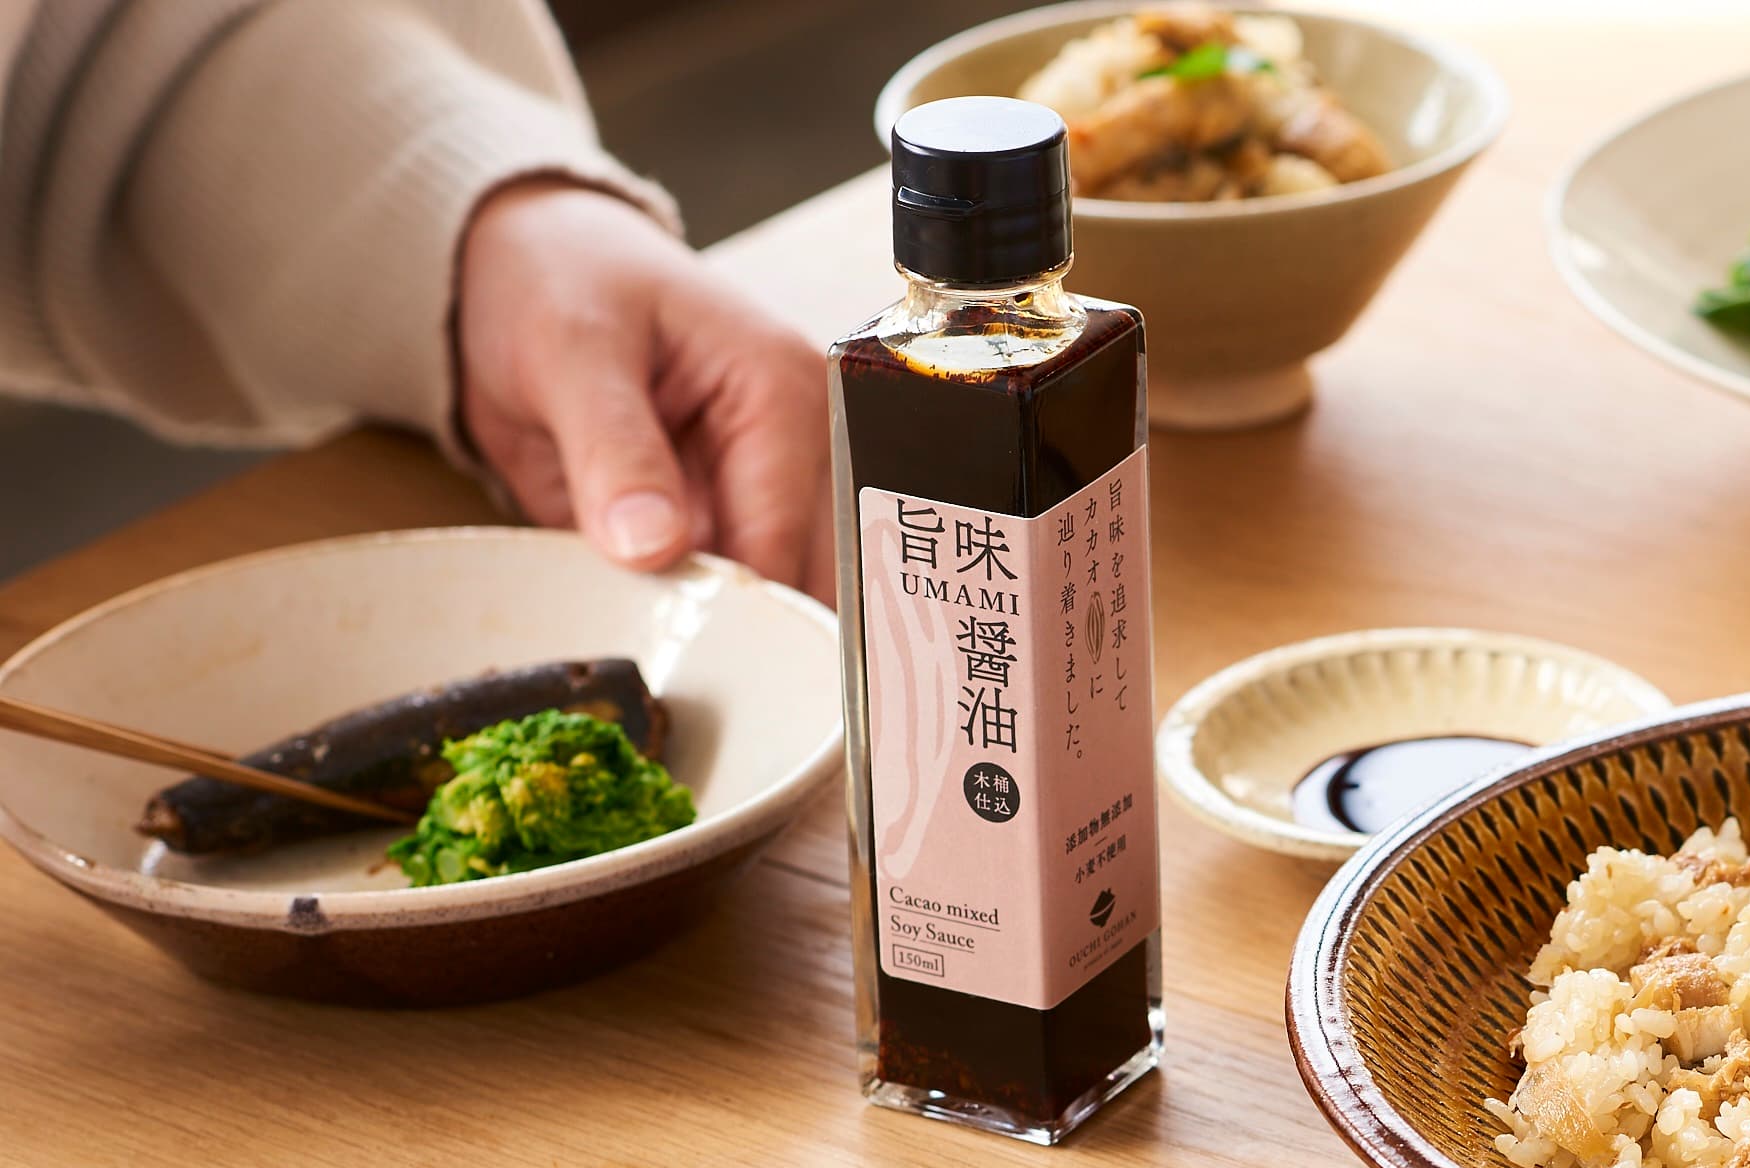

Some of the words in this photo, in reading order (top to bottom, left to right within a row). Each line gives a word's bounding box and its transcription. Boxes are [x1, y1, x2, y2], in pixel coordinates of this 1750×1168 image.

[897, 498, 1018, 581] 旨味
[900, 572, 1020, 616] UMAMI
[1108, 478, 1128, 711] 旨味を追求して
[1057, 512, 1083, 760] 辿り着きました。
[956, 616, 1018, 754] 醤油
[973, 771, 1009, 793] 木桶
[974, 792, 1011, 815] 仕込
[1065, 793, 1133, 856] 添加物無添加
[1075, 834, 1126, 884] 小麦不使用
[889, 886, 941, 913] Cacao
[947, 903, 999, 926] mixed
[890, 914, 921, 941] Soy
[926, 922, 975, 949] Sauce
[1069, 936, 1100, 968] OUCHI
[1103, 910, 1137, 943] GOHAN
[899, 951, 939, 972] 150ml
